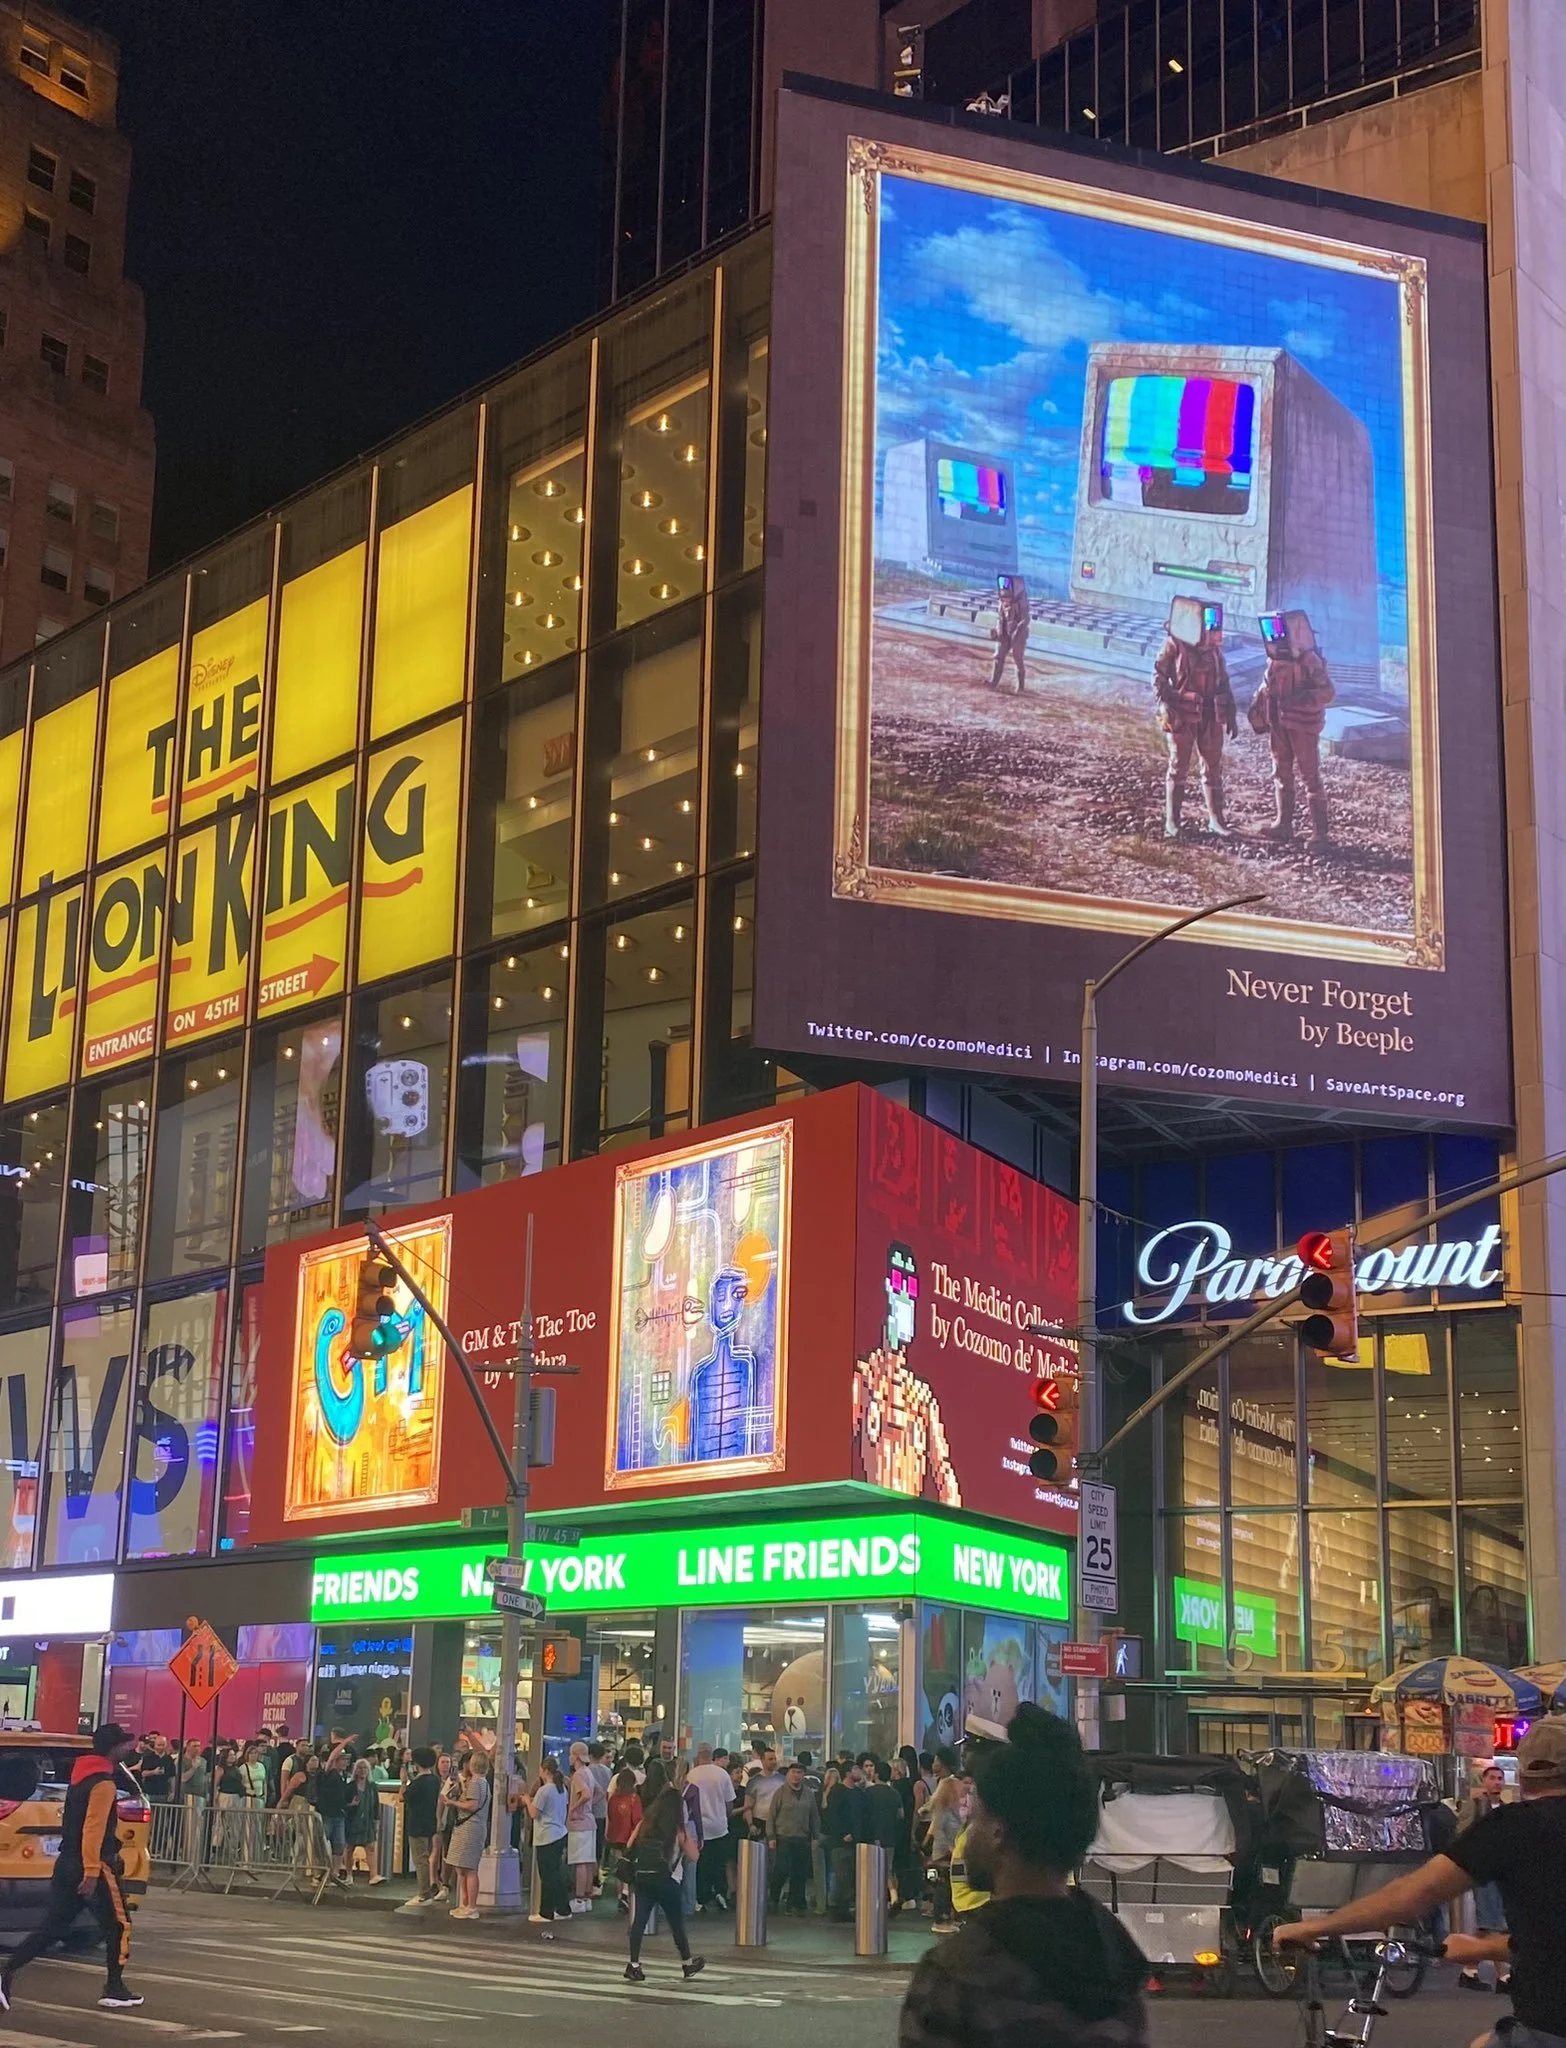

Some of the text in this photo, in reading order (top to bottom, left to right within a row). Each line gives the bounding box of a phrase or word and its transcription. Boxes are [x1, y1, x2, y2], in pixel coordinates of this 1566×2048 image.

[146, 675, 261, 799] THE
[28, 755, 426, 1042] LION KING
[1226, 968, 1413, 1020] Never Forget
[89, 971, 309, 1061] ENTRANCE ON 45TH STREET
[1300, 1016, 1414, 1055] by Beeple
[807, 1022, 1032, 1059] Twitter.com/CozomoMedici
[1063, 1050, 1298, 1087] Inagram.com/CozomoMedici
[1326, 1078, 1465, 1108] SaveArtSpace.org
[1123, 1220, 1503, 1325] Paraount
[931, 1262, 960, 1302] The
[964, 1276, 1012, 1325] Medici
[462, 1327, 490, 1353] GM
[492, 1325, 506, 1348] &
[536, 1315, 564, 1338] Tac
[566, 1308, 596, 1333] Toe
[931, 1303, 951, 1349] by
[954, 1316, 1011, 1366] Cozomo
[1014, 1339, 1034, 1373] de'
[1088, 1504, 1108, 1517] SPEED
[1091, 1490, 1105, 1501] CITY
[482, 1510, 488, 1524] 7
[538, 1528, 550, 1542] W
[554, 1529, 567, 1544] 45
[1090, 1518, 1106, 1531] LIMIT
[677, 1534, 921, 1585] LINE FRIENDS
[953, 1543, 1061, 1600] NEW YORK
[1087, 1535, 1112, 1571] 25
[312, 1567, 419, 1605] FRIENDS
[541, 1553, 627, 1593] YORK
[1091, 1584, 1109, 1595] PHOTO
[502, 1593, 539, 1611] ONE WAY
[1085, 1595, 1114, 1606] ENFORCED
[263, 1708, 286, 1721] RETAIL
[264, 1692, 298, 1705] FLAGSHIP
